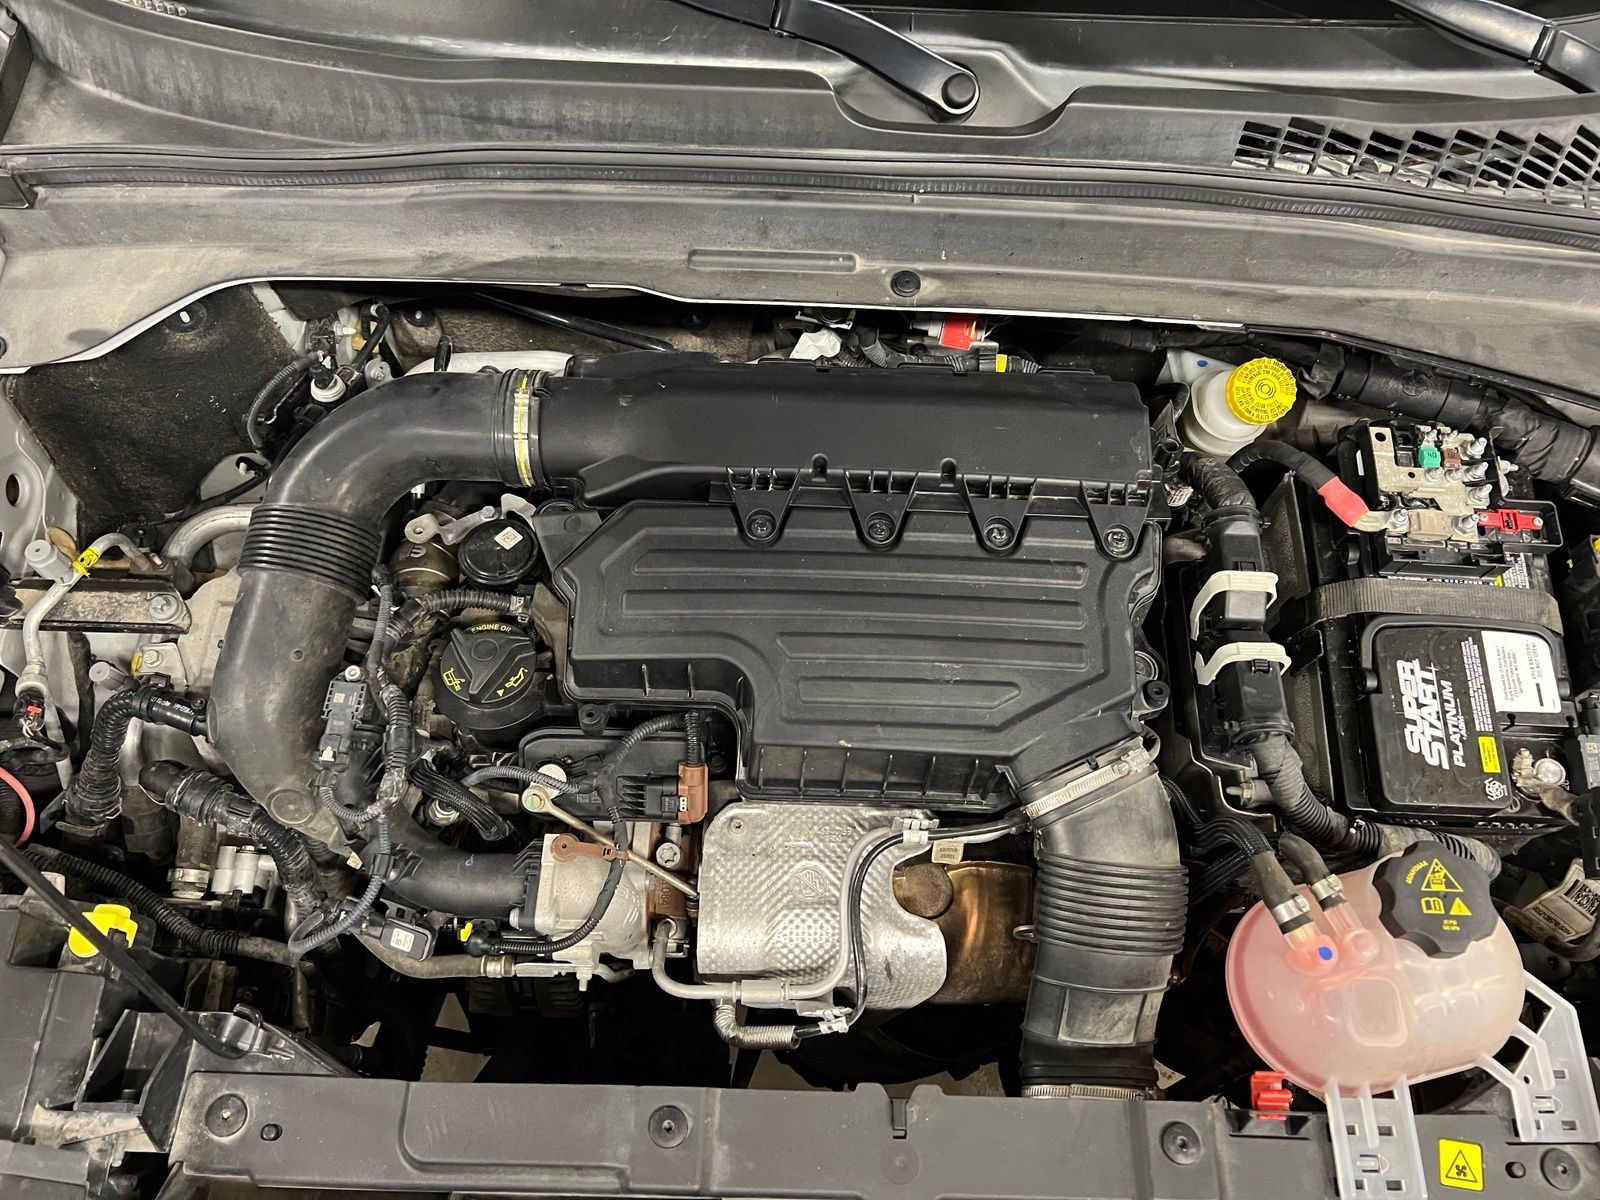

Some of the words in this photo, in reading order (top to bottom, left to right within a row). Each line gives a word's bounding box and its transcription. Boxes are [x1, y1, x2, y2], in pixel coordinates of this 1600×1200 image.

[471, 624, 499, 633] ENGINE
[1396, 659, 1421, 754] SUPER
[1412, 659, 1450, 770] START
[1440, 680, 1467, 768] PLATINUM
